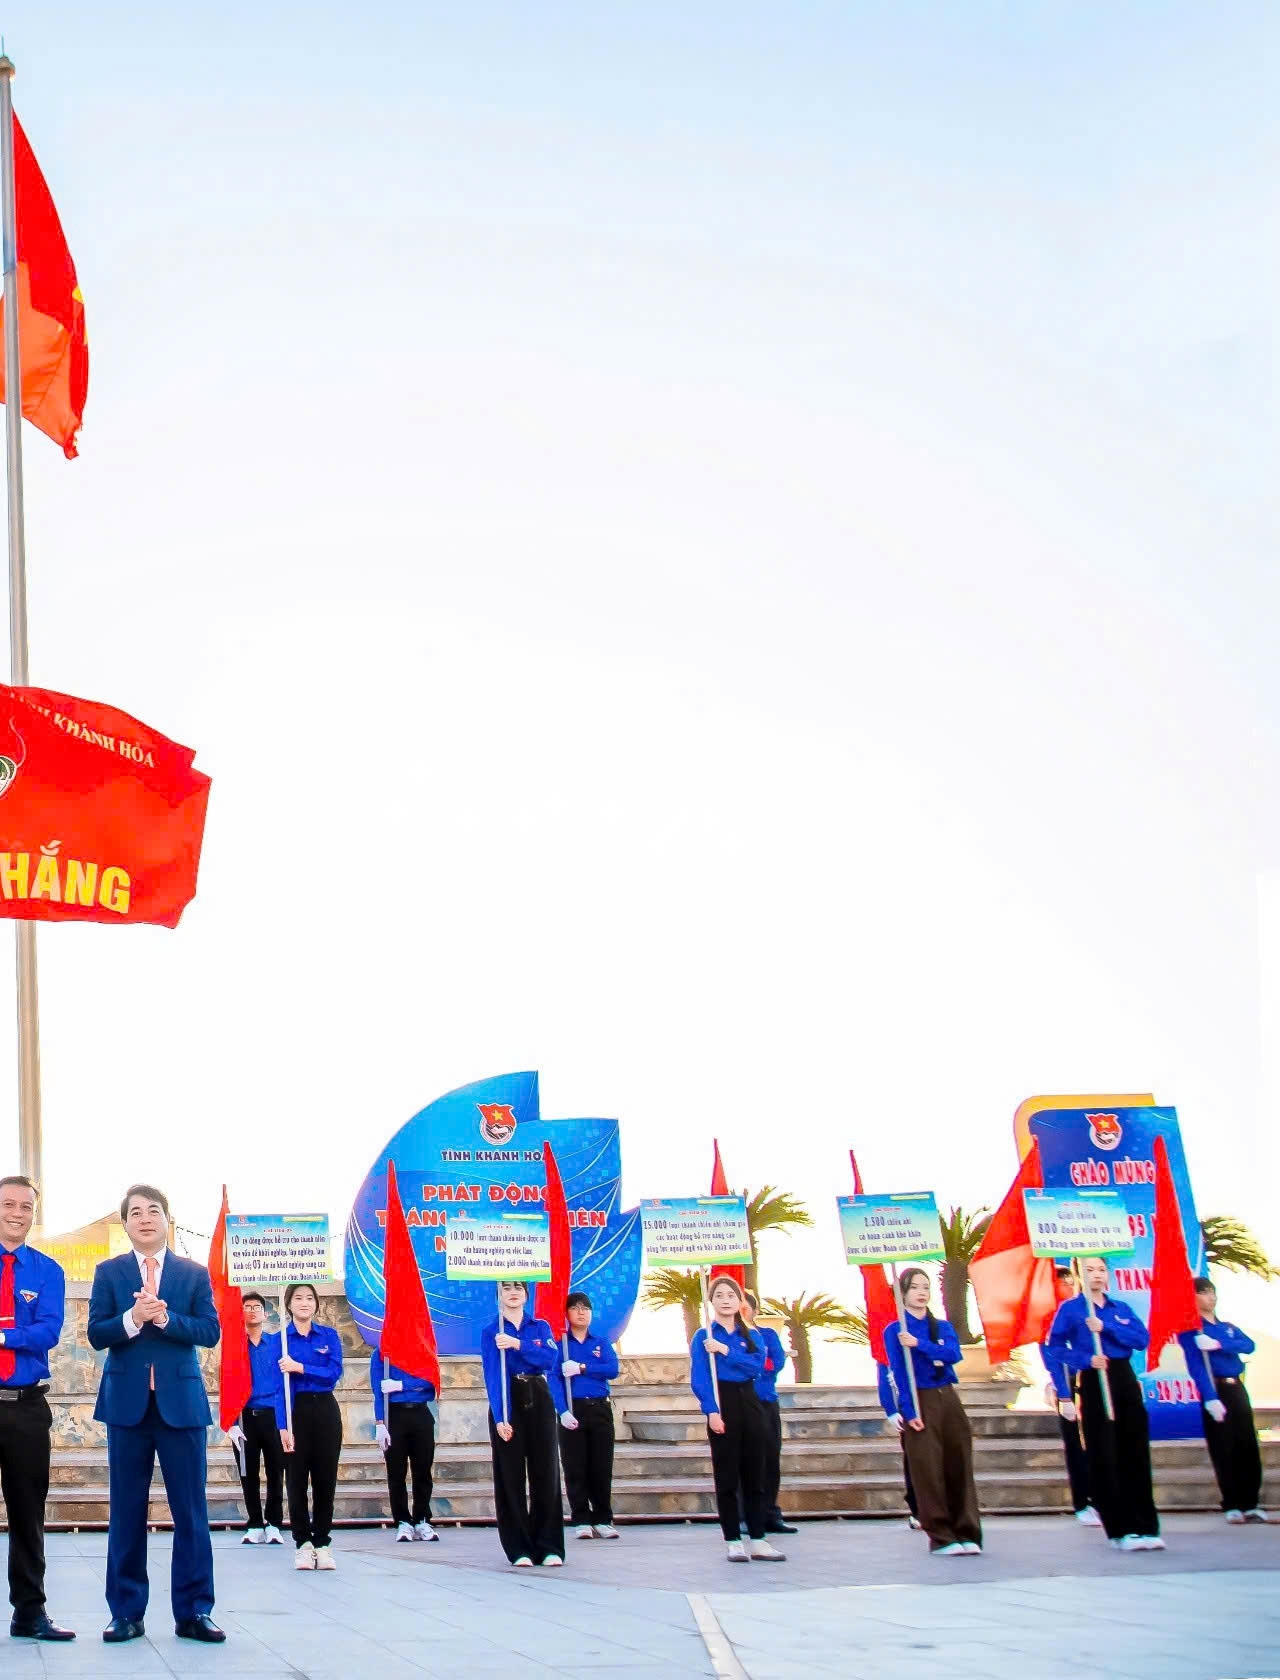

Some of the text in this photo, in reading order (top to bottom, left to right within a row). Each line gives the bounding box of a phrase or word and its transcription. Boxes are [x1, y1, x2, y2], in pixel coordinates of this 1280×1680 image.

[53, 711, 116, 752] KHÁNH
[118, 739, 155, 769] HÒA
[441, 1149, 471, 1161] TỈNH
[475, 1149, 519, 1161] KHÁNH
[1070, 1155, 1155, 1186] CHÀO MỪNG
[423, 1182, 481, 1202] PHÁT
[570, 1208, 607, 1227] IÊN
[643, 1220, 667, 1230] 15.000
[450, 1230, 474, 1241] 10.000
[448, 1256, 466, 1265] 2.000
